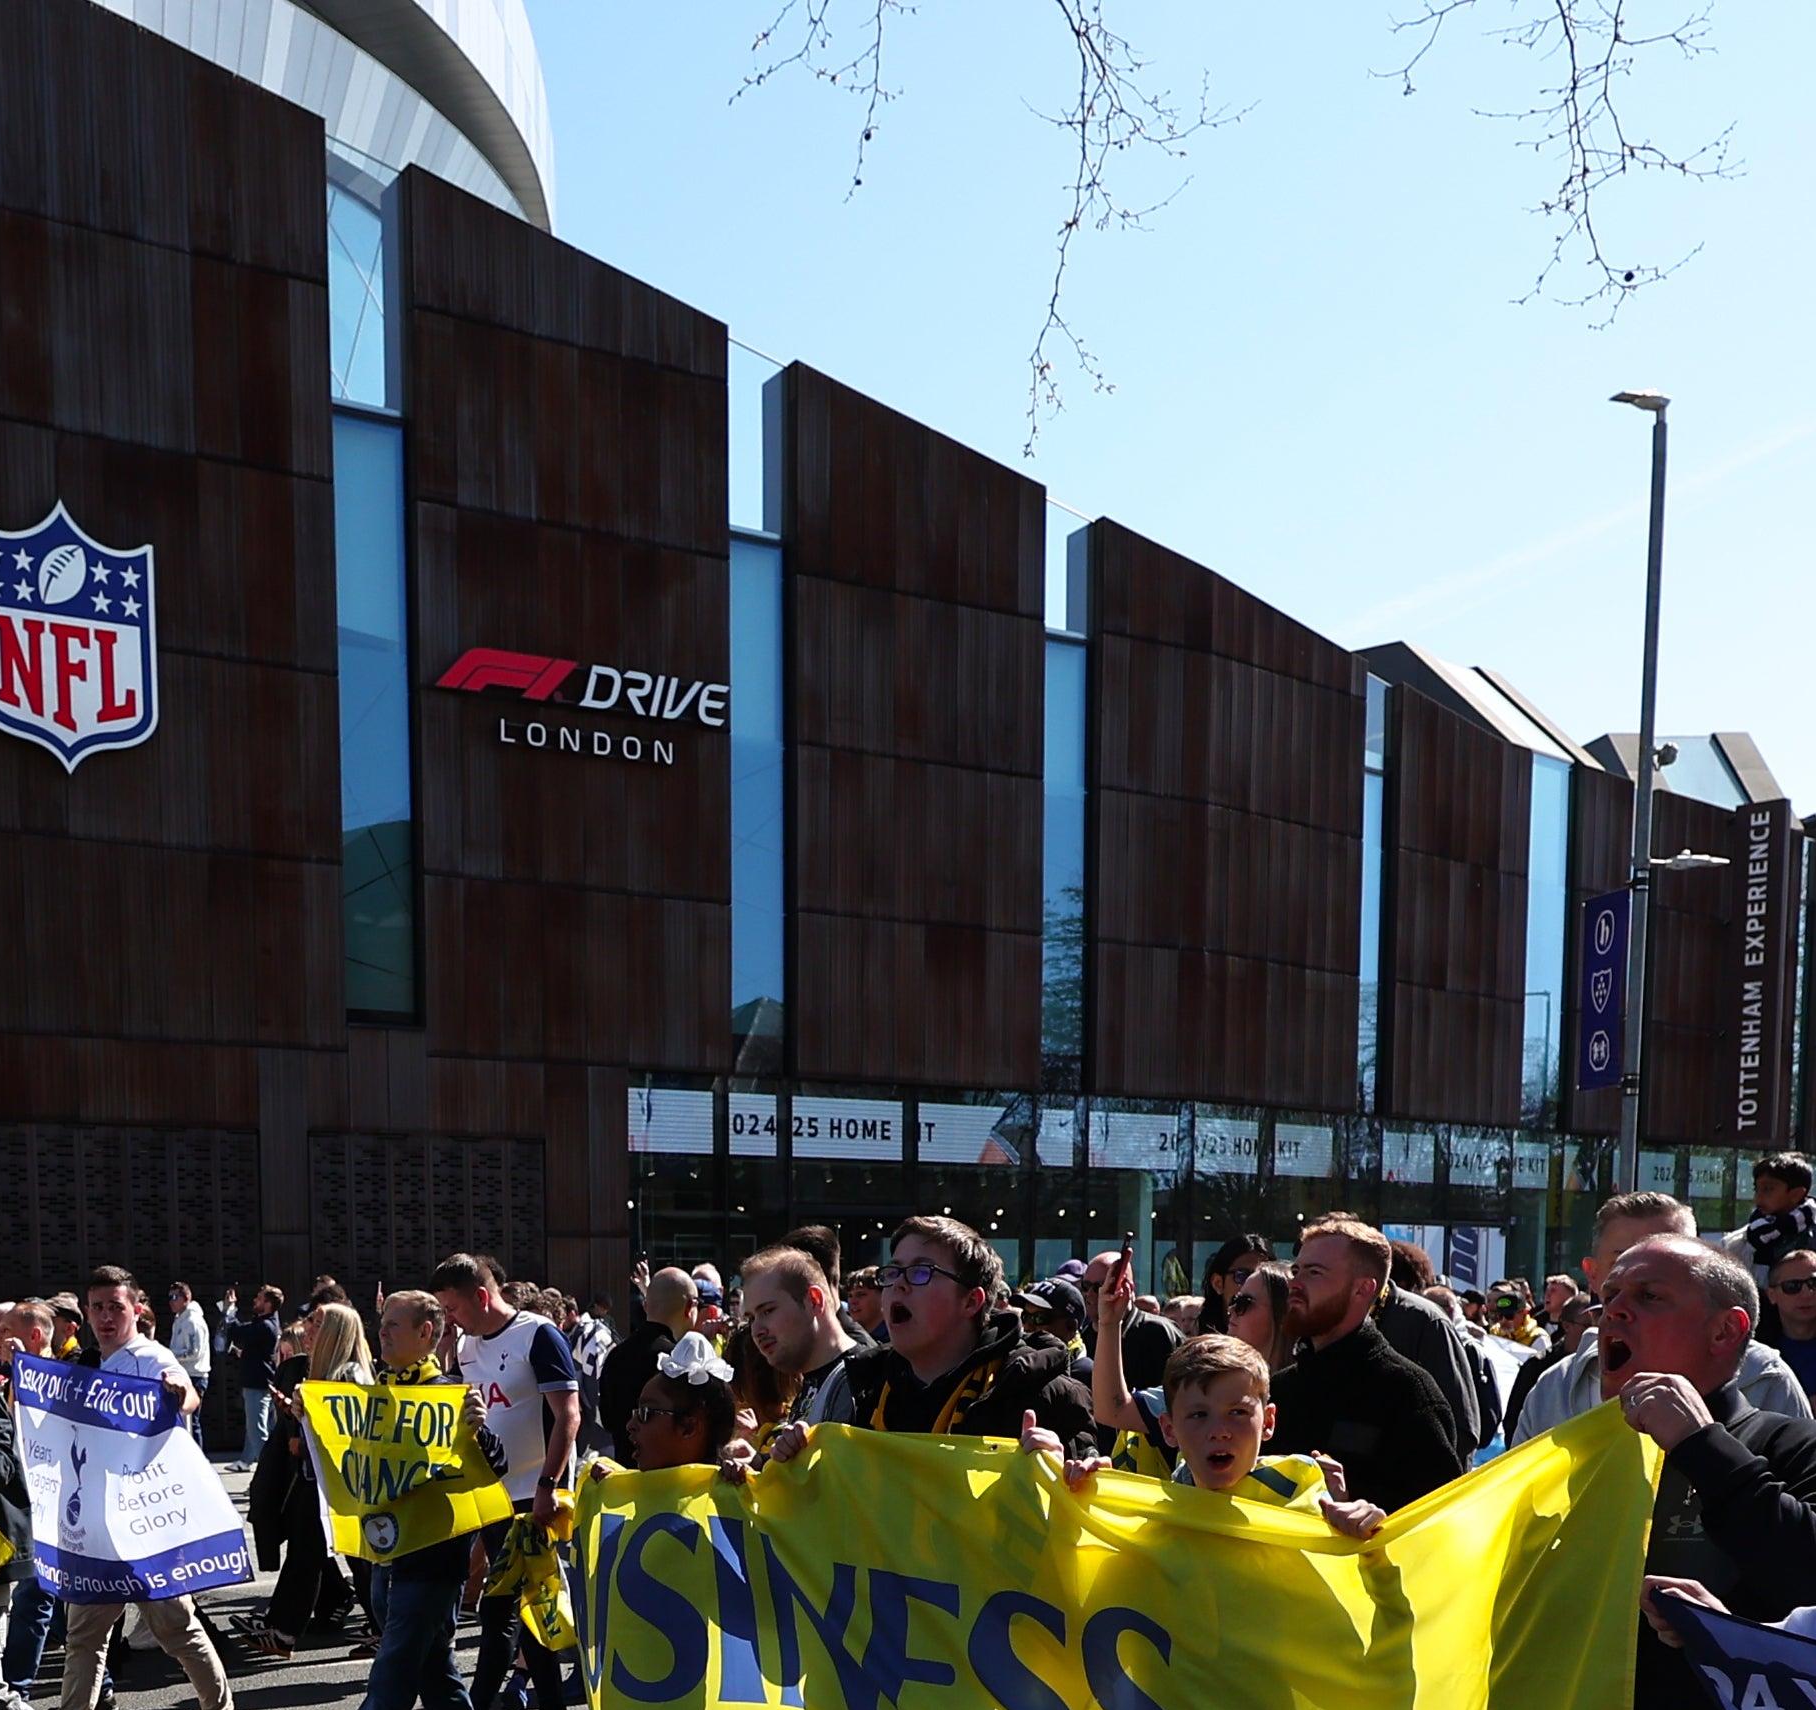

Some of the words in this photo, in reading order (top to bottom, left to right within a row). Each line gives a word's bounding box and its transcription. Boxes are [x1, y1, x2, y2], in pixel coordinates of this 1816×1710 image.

[579, 664, 730, 726] DRIVE
[500, 718, 674, 764] LONDON
[1745, 810, 1771, 967] EXPERIENCE
[1738, 981, 1763, 1131] TOTTENHAM
[732, 1113, 819, 1139] 02425
[829, 1117, 892, 1141] HOME
[918, 1121, 936, 1142] IT
[1278, 1141, 1301, 1159] KIT
[18, 1360, 47, 1403] Levy
[84, 1378, 121, 1415] Enic
[122, 1388, 157, 1421] out
[480, 1381, 512, 1409] IA
[323, 1394, 389, 1442] TIME
[392, 1399, 455, 1448] FOR
[28, 1469, 59, 1494] nagers
[118, 1482, 184, 1512] Before
[122, 1460, 169, 1486] Profit
[129, 1507, 187, 1536] Glory
[74, 1574, 143, 1596] enough
[145, 1572, 168, 1590] is
